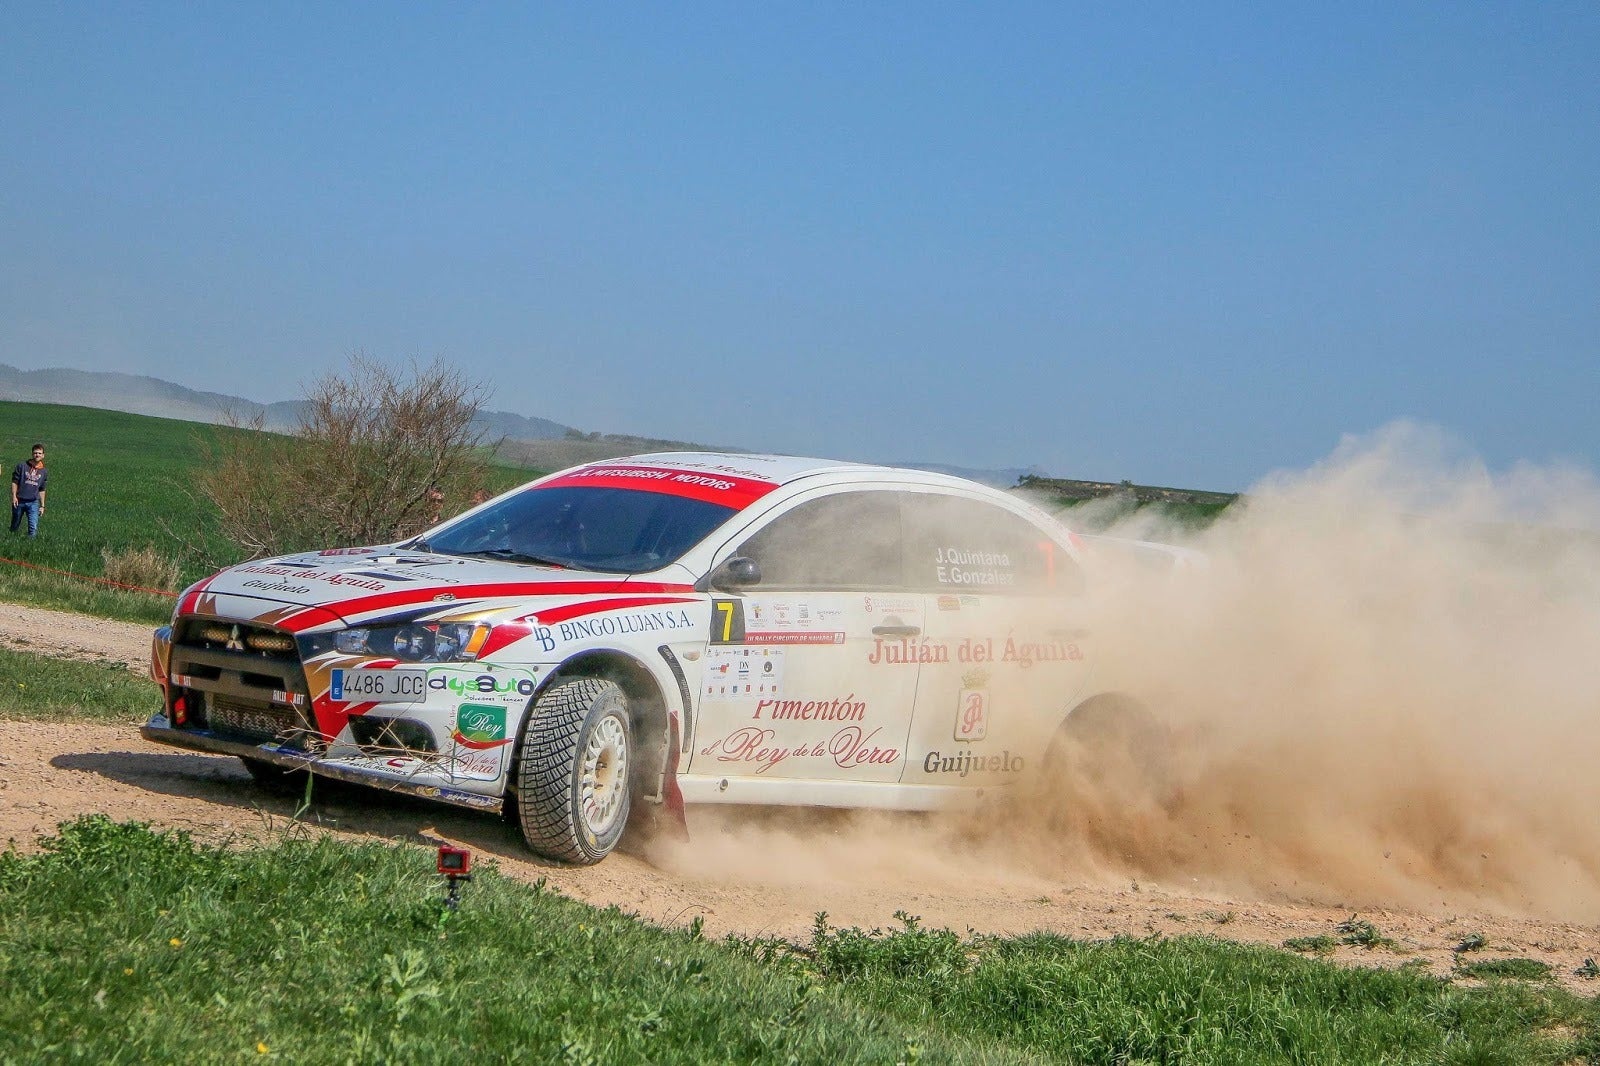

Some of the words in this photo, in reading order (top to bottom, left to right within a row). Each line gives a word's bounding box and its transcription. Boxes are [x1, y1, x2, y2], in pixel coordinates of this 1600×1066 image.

[671, 473, 736, 490] MOTORS
[935, 547, 1010, 567] J.Quintana
[242, 579, 311, 595] Guijuelo
[560, 618, 615, 641] BINGO
[667, 610, 694, 629] S.A.
[716, 602, 734, 642] 7
[868, 636, 949, 664] Julián
[958, 638, 994, 662] del
[334, 687, 340, 695] E
[344, 675, 384, 694] 4486
[390, 675, 423, 695] JCC
[753, 694, 866, 721] Pimentón
[461, 710, 473, 719] el
[467, 712, 503, 738] Rey
[701, 740, 717, 756] el
[717, 727, 793, 774] Rey
[792, 743, 808, 757] de
[811, 743, 826, 757] la
[828, 726, 901, 768] Vera
[923, 751, 1025, 777] Guijuelo
